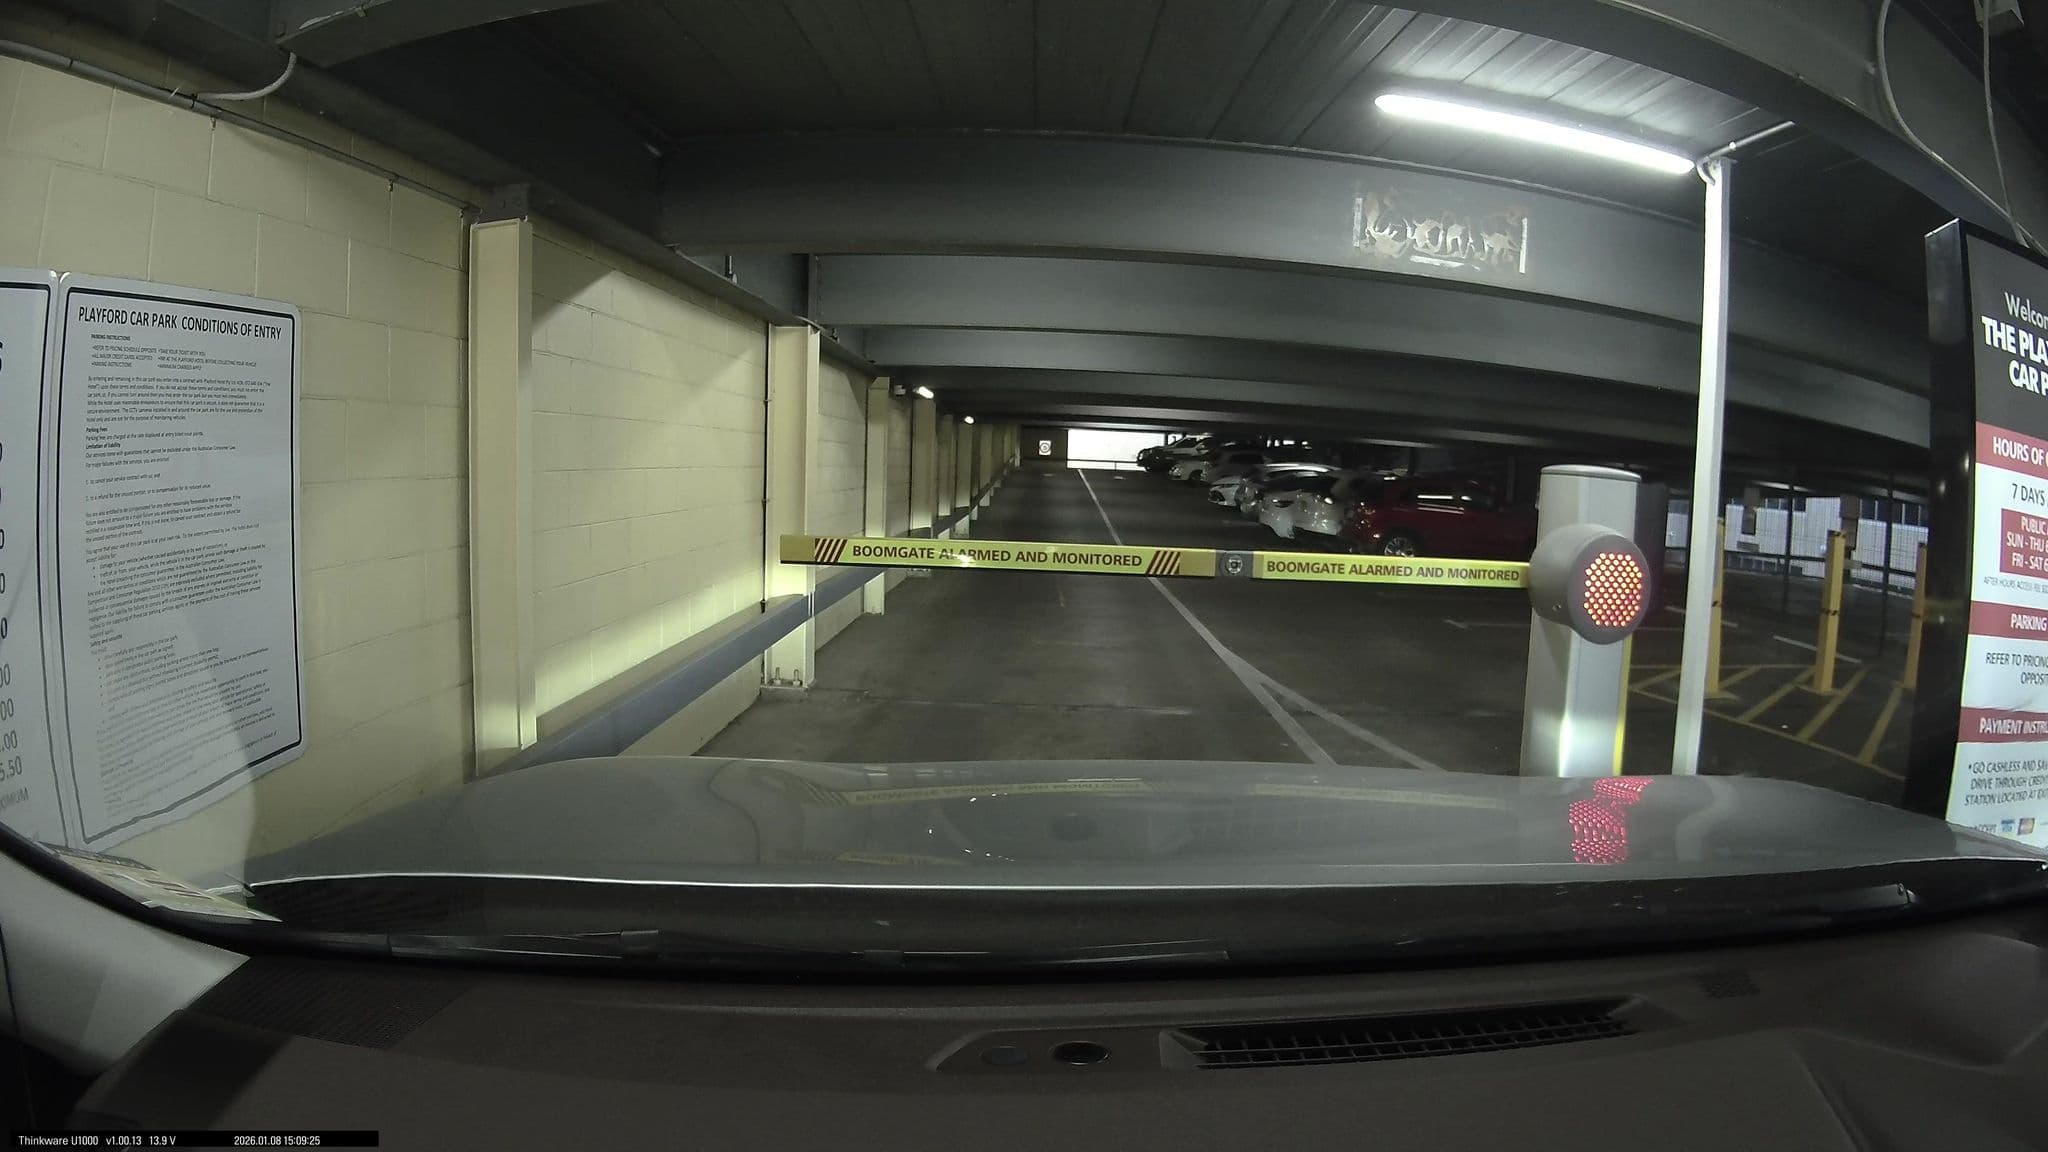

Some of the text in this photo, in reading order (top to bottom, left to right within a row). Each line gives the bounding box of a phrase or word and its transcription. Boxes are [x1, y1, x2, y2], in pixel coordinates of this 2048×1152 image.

[78, 306, 282, 340] PLAYFORD CAR PARK CONDITIONS OF ENTRY
[1982, 315, 2017, 354] THE
[2009, 359, 2040, 394] CAR
[1992, 436, 2029, 462] HOURS
[2031, 446, 2044, 466] OF
[2012, 482, 2045, 506] 7 DAYS
[2020, 516, 2046, 536] PUBLIC
[2006, 530, 2023, 548] SUN
[2029, 536, 2044, 552] THU
[852, 544, 1142, 568] BOOMGATE ALARMED AND MONITORED
[2012, 552, 2023, 568] FRI
[2029, 555, 2043, 571] SAT
[1266, 560, 1519, 581] BOOMGATE ALARMED AND MONITORED
[2011, 613, 2047, 631] PARKING
[1985, 652, 2010, 665] REFER
[2012, 654, 2022, 666] TO
[1979, 717, 2023, 735] PAYMENT
[1986, 760, 2021, 773] CASHLESS
[2023, 760, 2036, 772] AND
[1970, 777, 1993, 790] DRIVE
[1995, 776, 2026, 788] THROUGH
[1965, 794, 1995, 807] STATION
[1997, 790, 2028, 804] LOCATED
